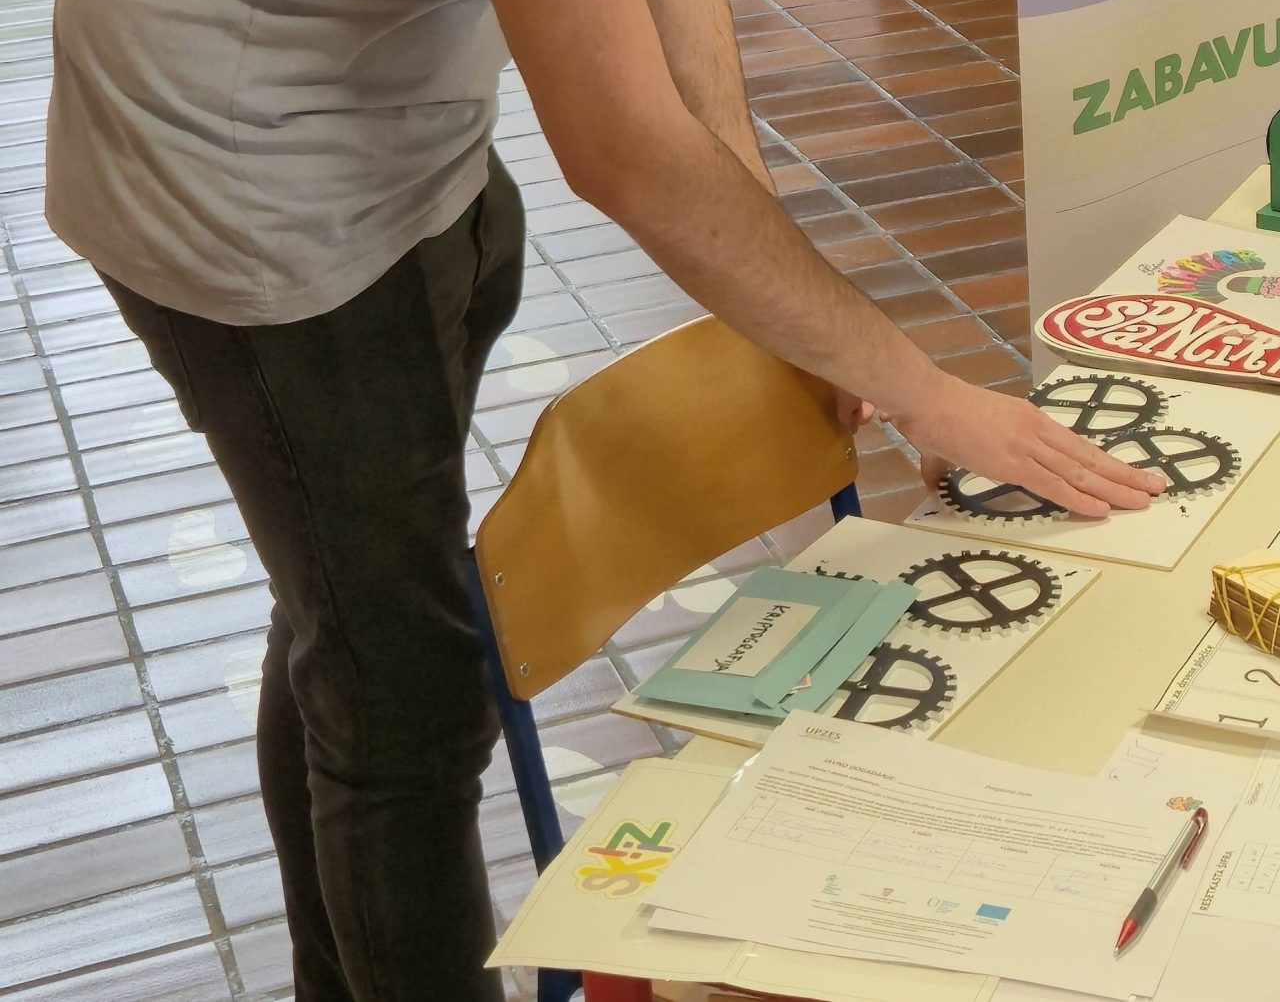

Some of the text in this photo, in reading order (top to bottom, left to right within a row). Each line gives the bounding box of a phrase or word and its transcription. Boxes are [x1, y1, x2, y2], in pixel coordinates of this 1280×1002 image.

[711, 604, 790, 672] KRIPTOGRAFIJA
[1219, 714, 1268, 727] 1
[1200, 850, 1233, 910] REŠETKASTA ŠIFRA
